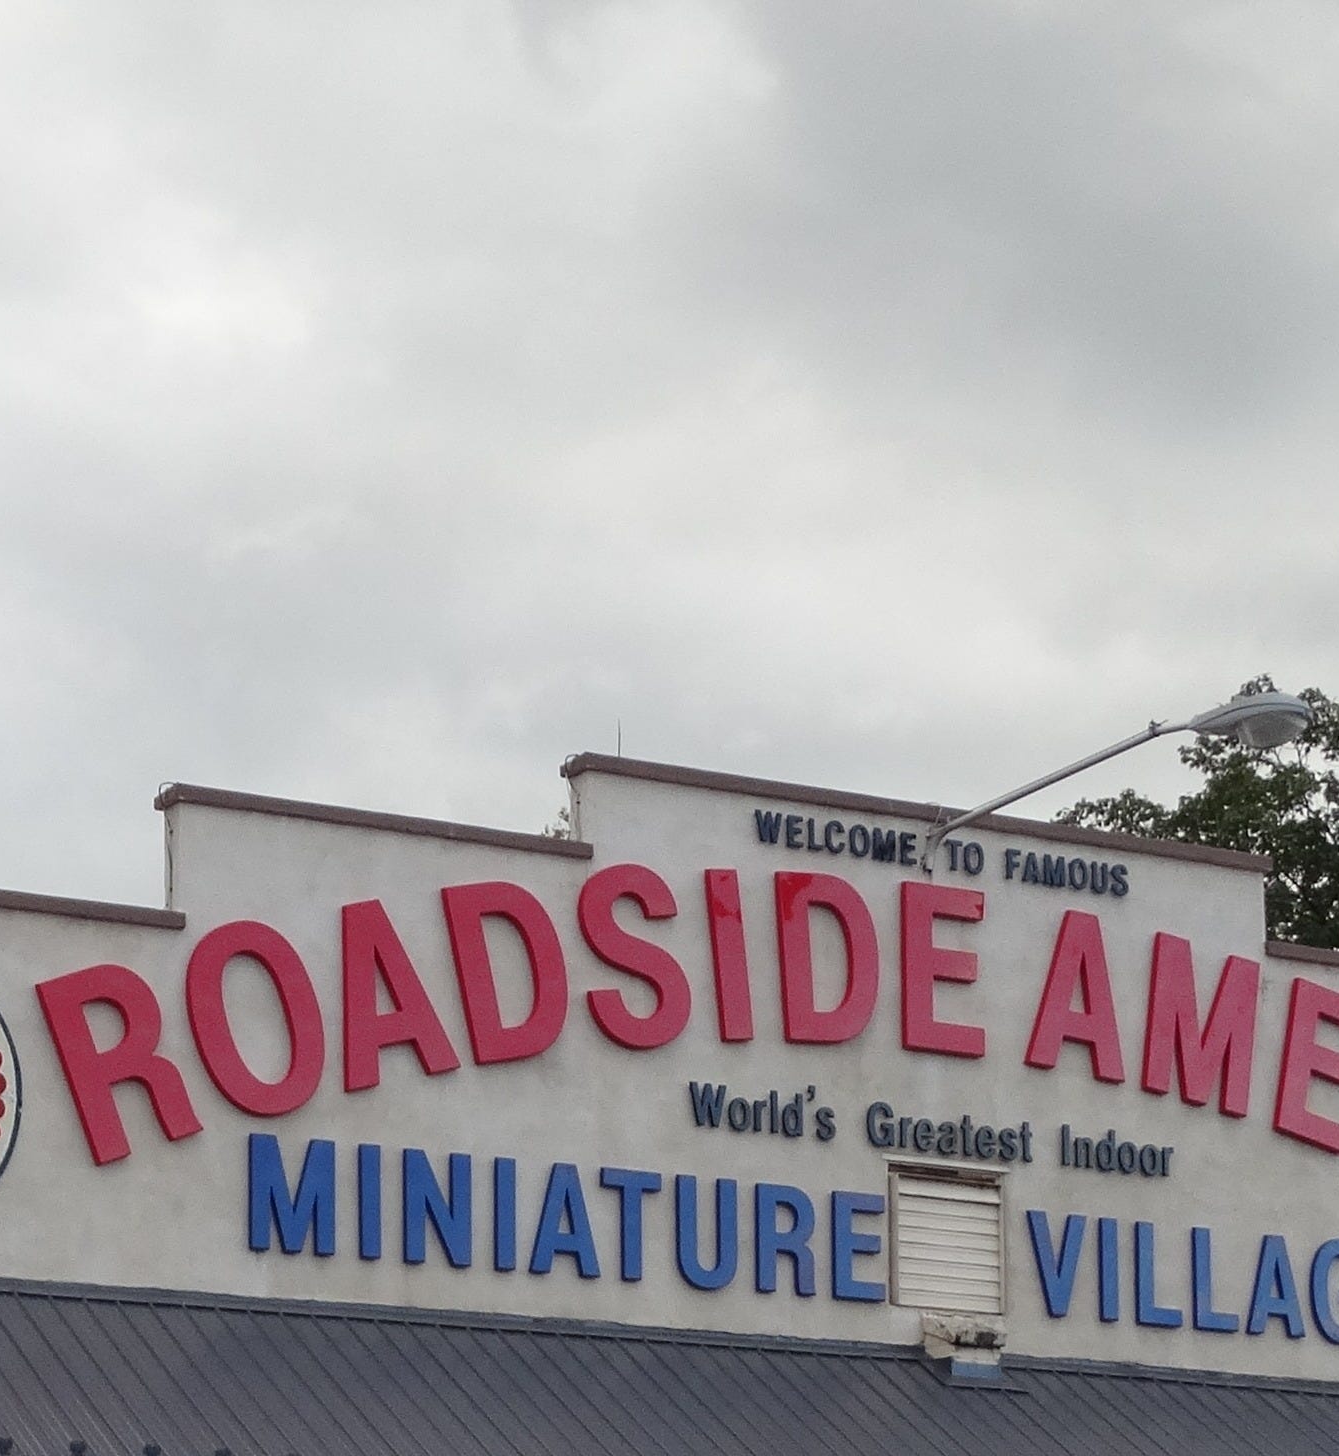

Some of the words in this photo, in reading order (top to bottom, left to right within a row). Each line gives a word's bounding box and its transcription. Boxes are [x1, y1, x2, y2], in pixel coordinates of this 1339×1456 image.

[754, 809, 918, 866] WELCOME
[945, 838, 984, 875] TO
[1004, 848, 1130, 896] FAMOUS
[35, 863, 985, 1167] ROADSIDE
[689, 1081, 837, 1142] World's
[866, 1101, 1033, 1163] Greatest
[1060, 1123, 1175, 1178] Indoor
[248, 1133, 887, 1303] MINIATURE
